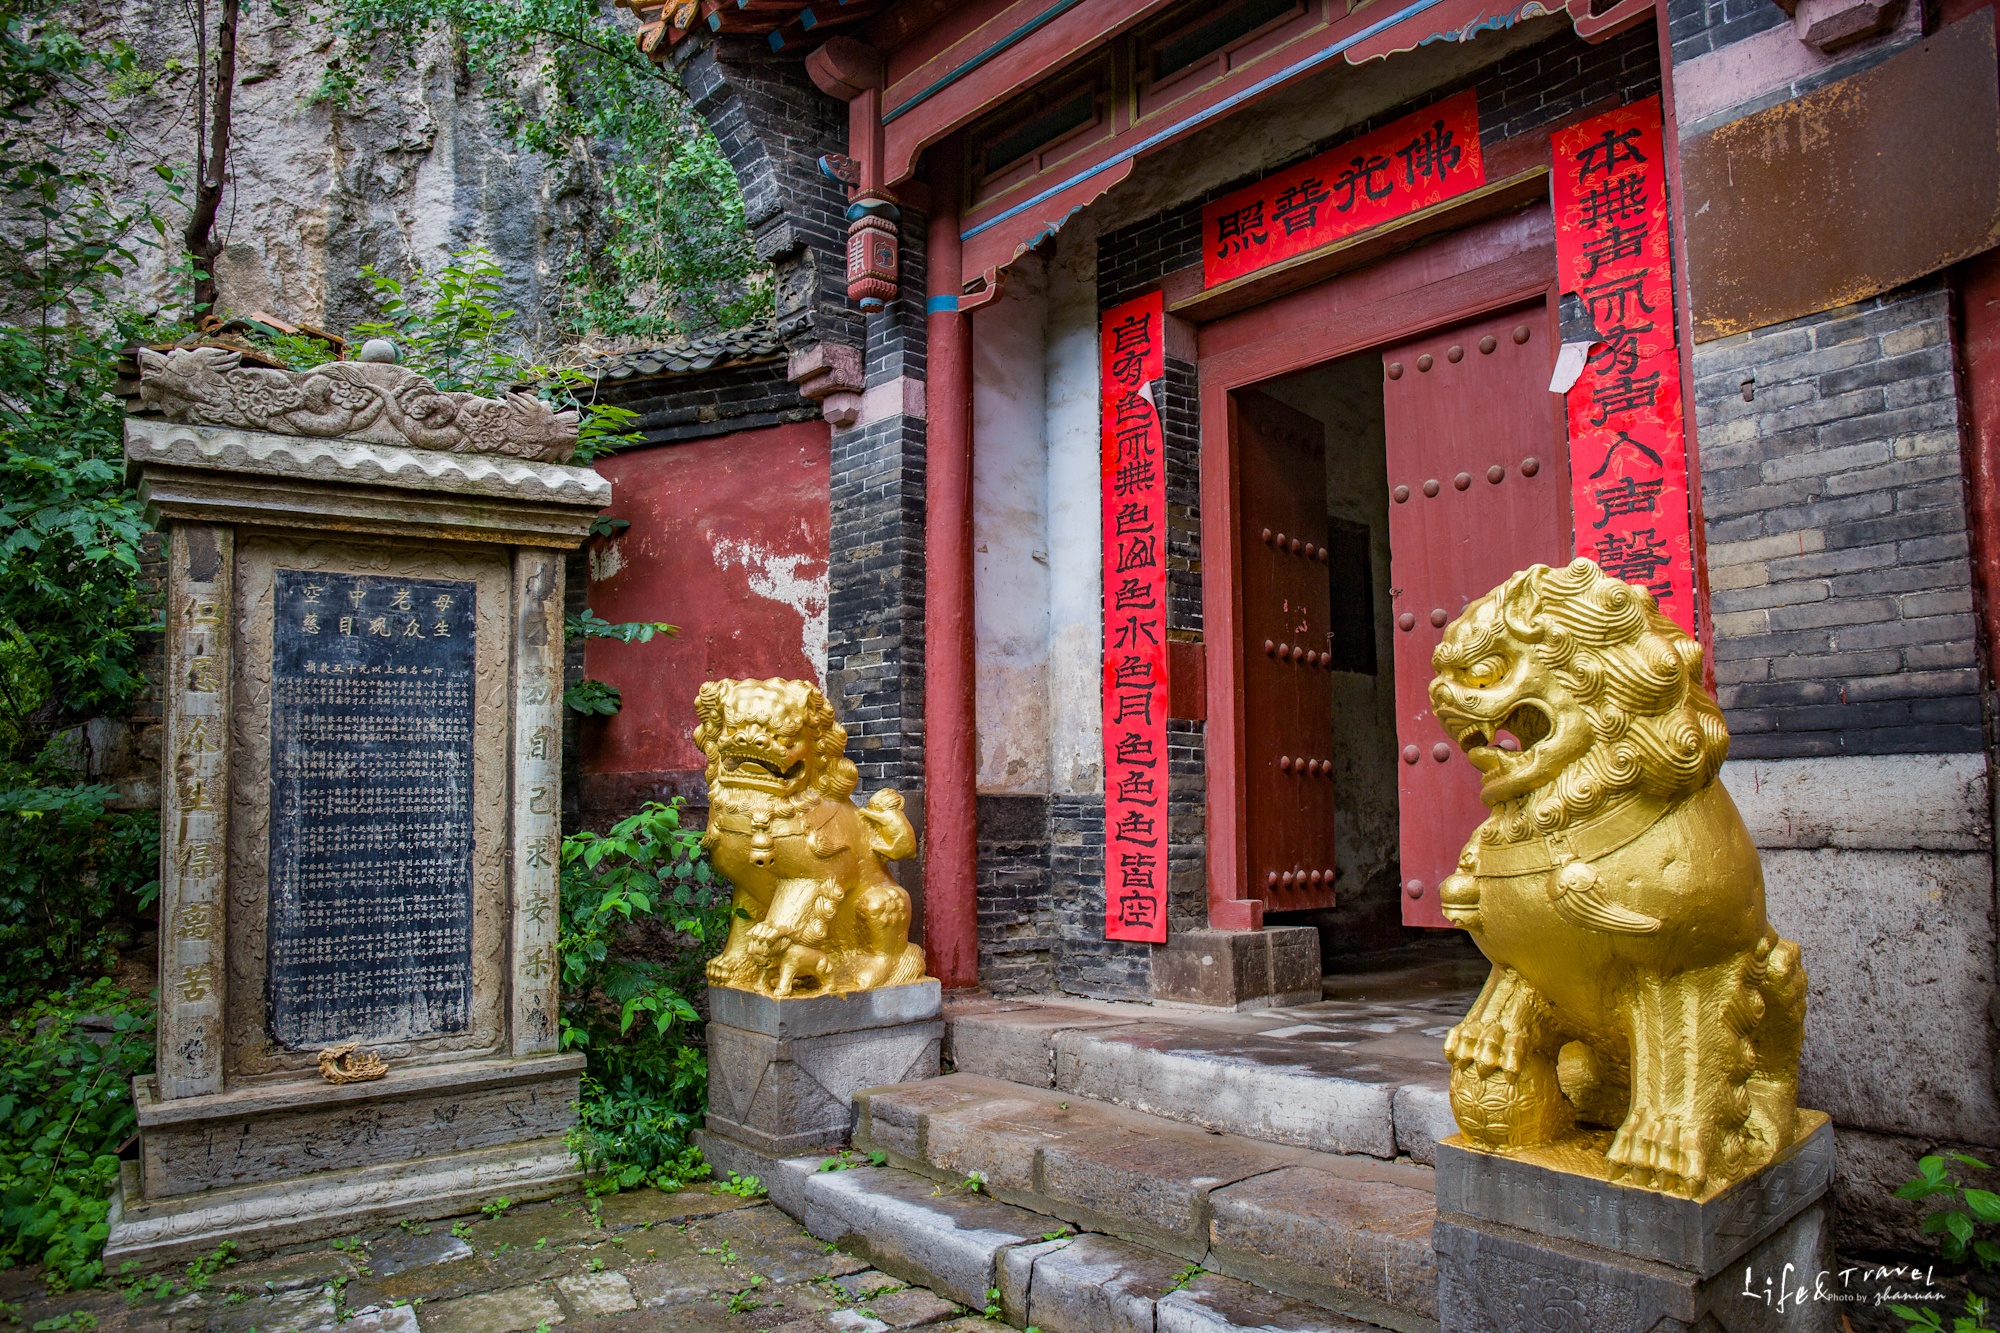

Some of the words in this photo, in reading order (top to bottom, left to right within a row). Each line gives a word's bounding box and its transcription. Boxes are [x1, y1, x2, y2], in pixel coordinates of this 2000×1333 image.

[1216, 119, 1461, 260] 佛光普照
[302, 579, 455, 612] 空中老母
[301, 612, 452, 639] 慈目观众生
[303, 660, 445, 678] 捐款五十元以上姓名如下
[175, 597, 223, 1003] 但愿众生得离苦
